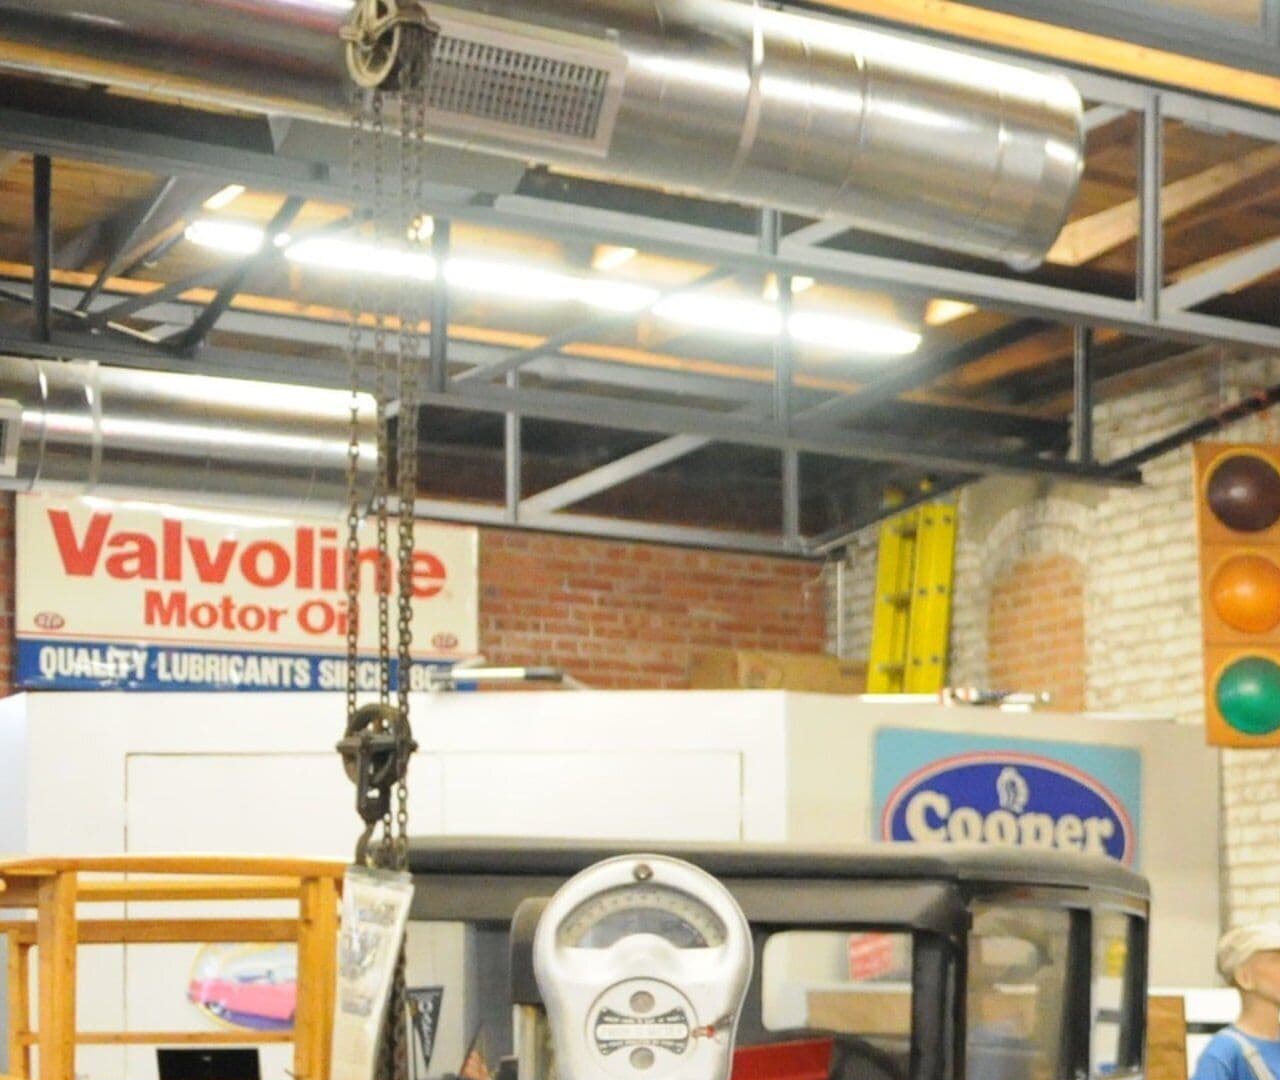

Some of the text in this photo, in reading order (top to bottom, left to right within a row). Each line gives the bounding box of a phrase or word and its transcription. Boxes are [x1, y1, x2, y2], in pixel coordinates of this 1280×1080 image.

[47, 508, 446, 598] Valvoline
[144, 590, 287, 633] Motor
[39, 646, 148, 680] QUALITY
[157, 650, 311, 689] LUBRICANTS
[905, 790, 1115, 853] Cooper
